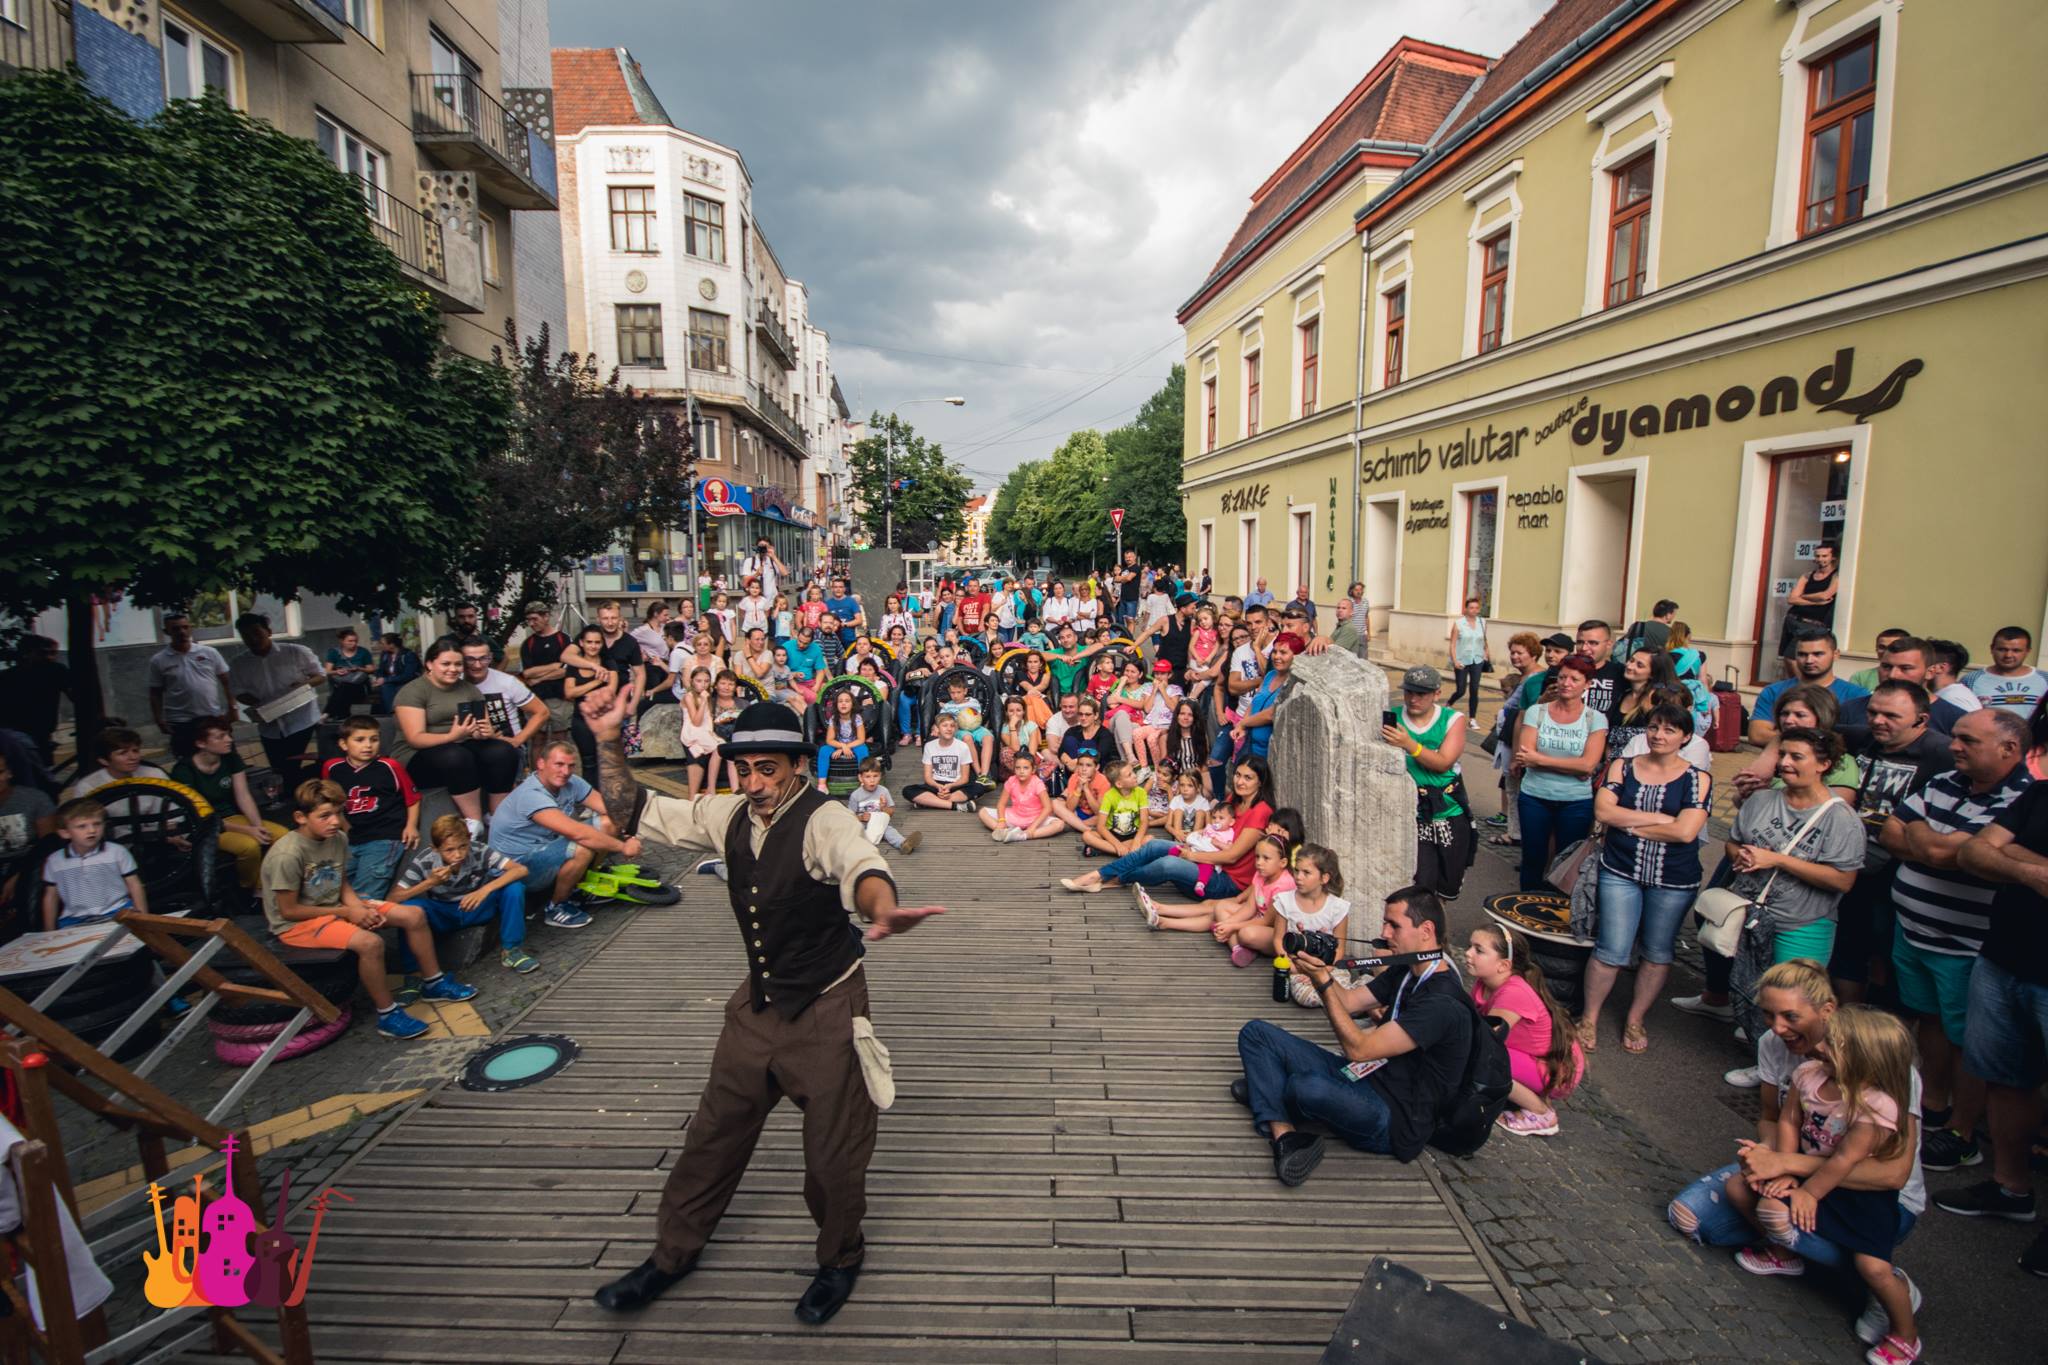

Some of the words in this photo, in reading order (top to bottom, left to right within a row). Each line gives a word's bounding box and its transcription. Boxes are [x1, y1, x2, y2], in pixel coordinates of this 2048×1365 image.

[1534, 396, 1589, 446] boutique
[1571, 347, 1856, 456] dyamond
[1362, 438, 1432, 484] schimb
[1438, 424, 1530, 470] valutar
[1518, 513, 1549, 528] man
[1416, 952, 1441, 960] LUMIX
